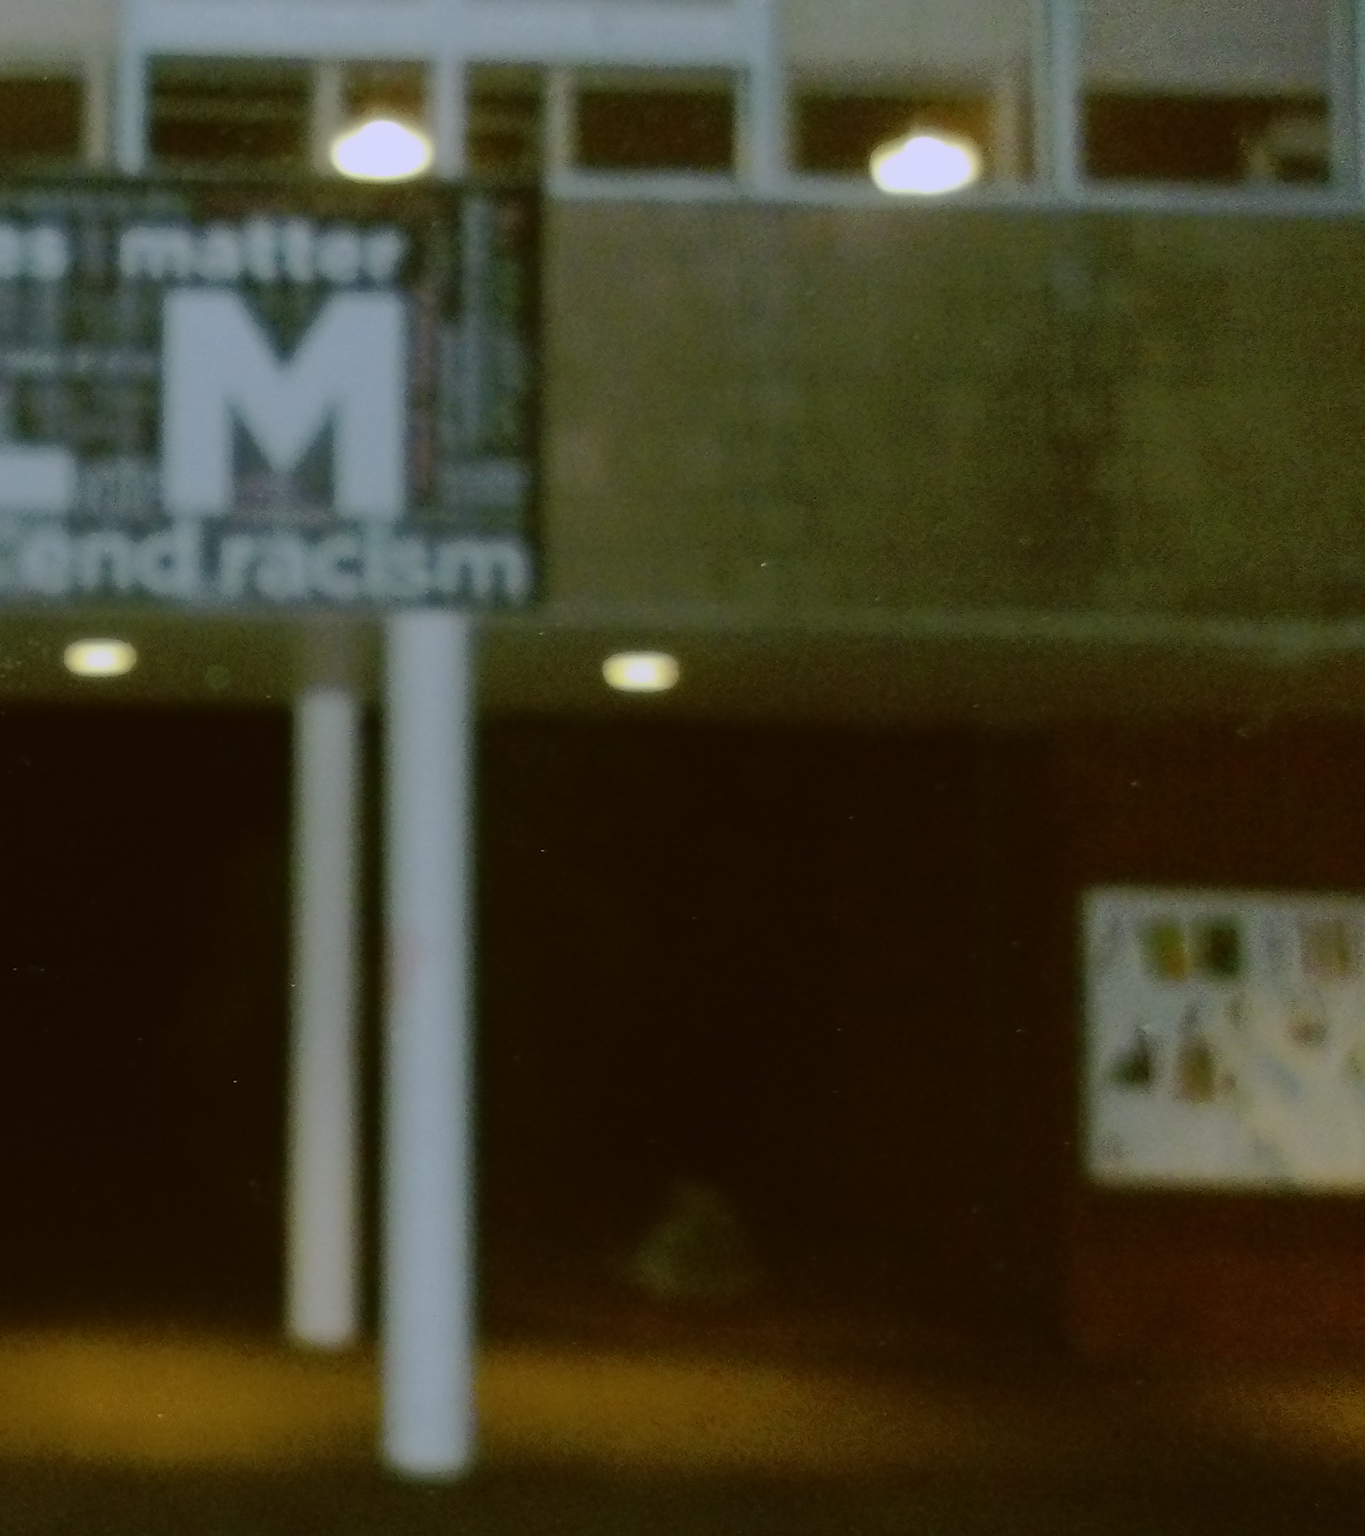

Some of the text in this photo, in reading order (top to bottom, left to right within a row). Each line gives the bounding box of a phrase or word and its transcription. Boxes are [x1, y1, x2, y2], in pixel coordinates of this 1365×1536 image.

[119, 217, 409, 284] matter
[18, 517, 203, 597] end
[215, 517, 532, 604] racism
